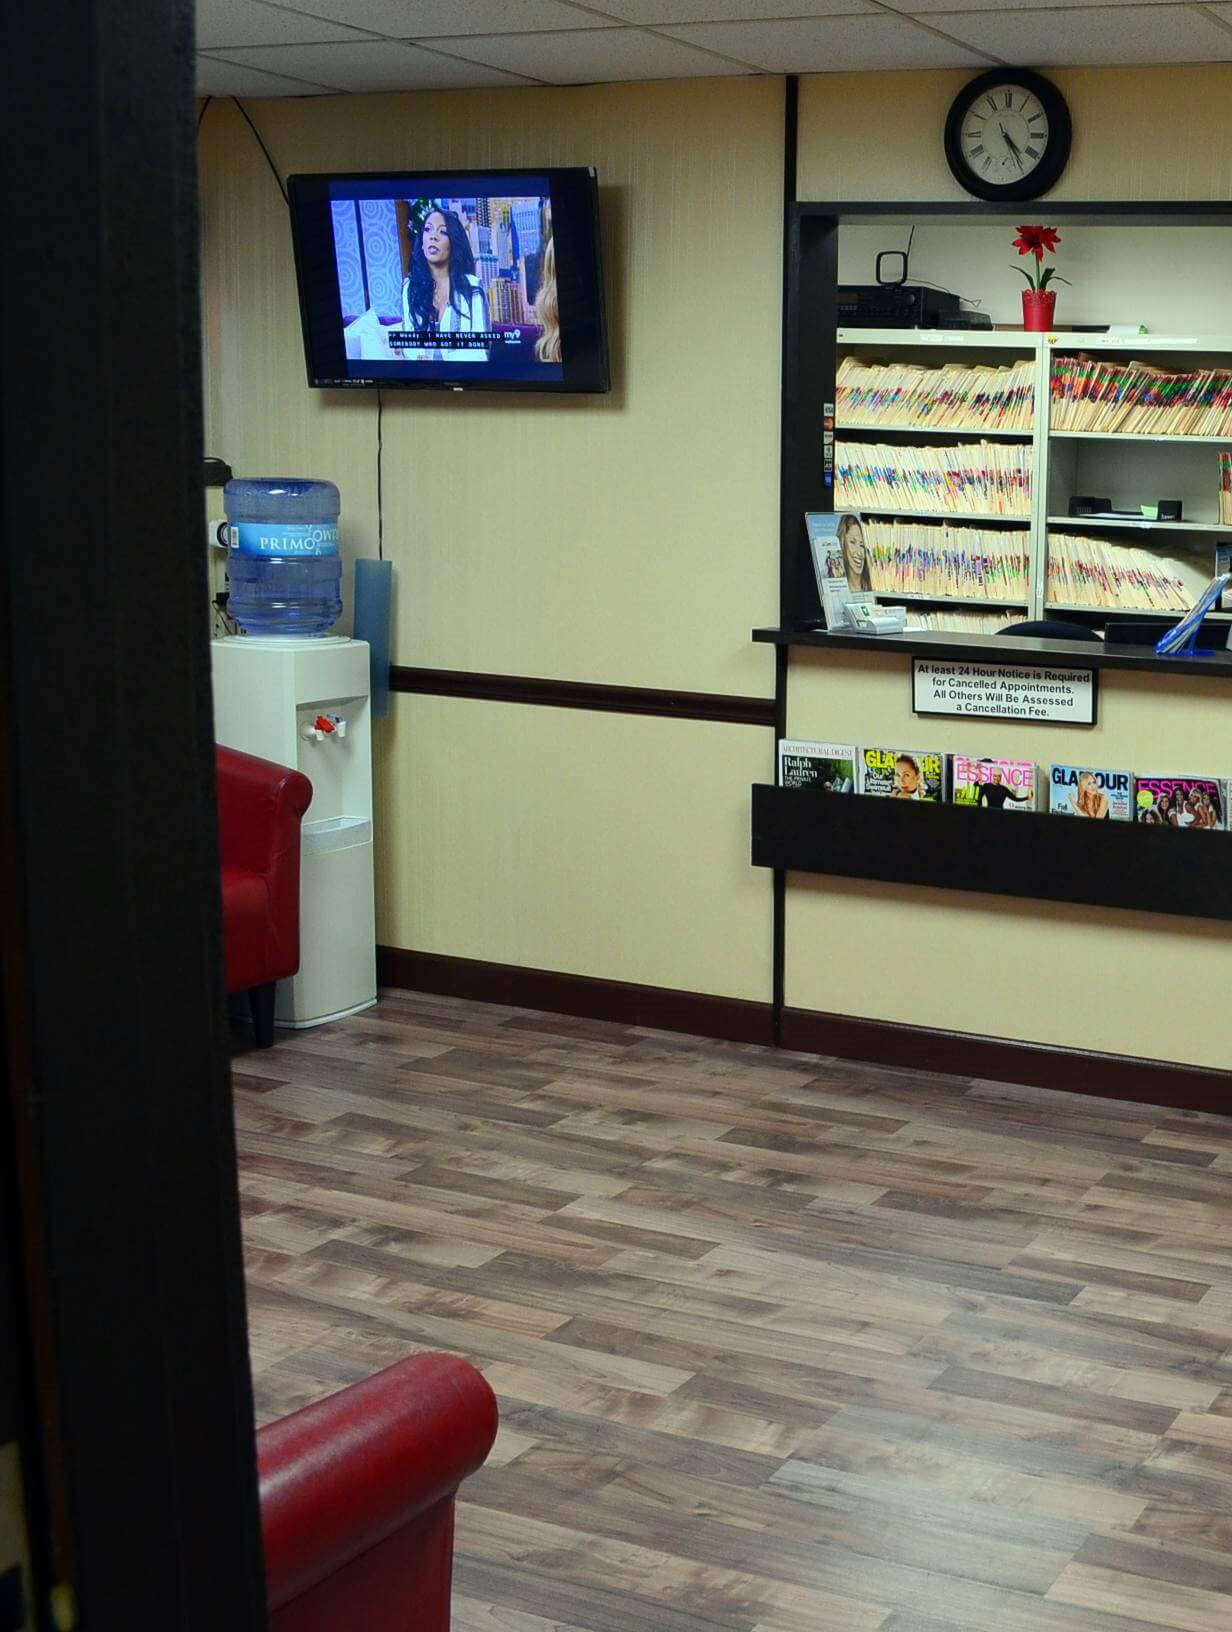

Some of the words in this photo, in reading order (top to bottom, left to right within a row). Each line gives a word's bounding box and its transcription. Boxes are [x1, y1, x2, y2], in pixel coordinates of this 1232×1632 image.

[260, 537, 315, 550] PRIMO
[918, 664, 929, 674] At
[931, 665, 955, 675] least
[958, 667, 970, 676] 24
[972, 667, 997, 677] Hour
[998, 669, 1030, 680] Notice
[1033, 671, 1042, 680] is
[1044, 671, 1090, 683] Required
[932, 677, 946, 687] for
[948, 678, 997, 690] Cancelled
[1000, 681, 1074, 694] Appointments.
[933, 690, 946, 699] All
[948, 690, 983, 701] Others
[985, 692, 1003, 702] Will
[1005, 694, 1019, 703] Be
[1022, 694, 1074, 707] Assessed
[965, 703, 1026, 715] Cancellation
[1028, 707, 1050, 717] Fee.
[784, 757, 812, 768] Ralph
[866, 750, 941, 773] GLAUR
[784, 766, 818, 778] Lauren
[1052, 767, 1129, 791] GLAOUR
